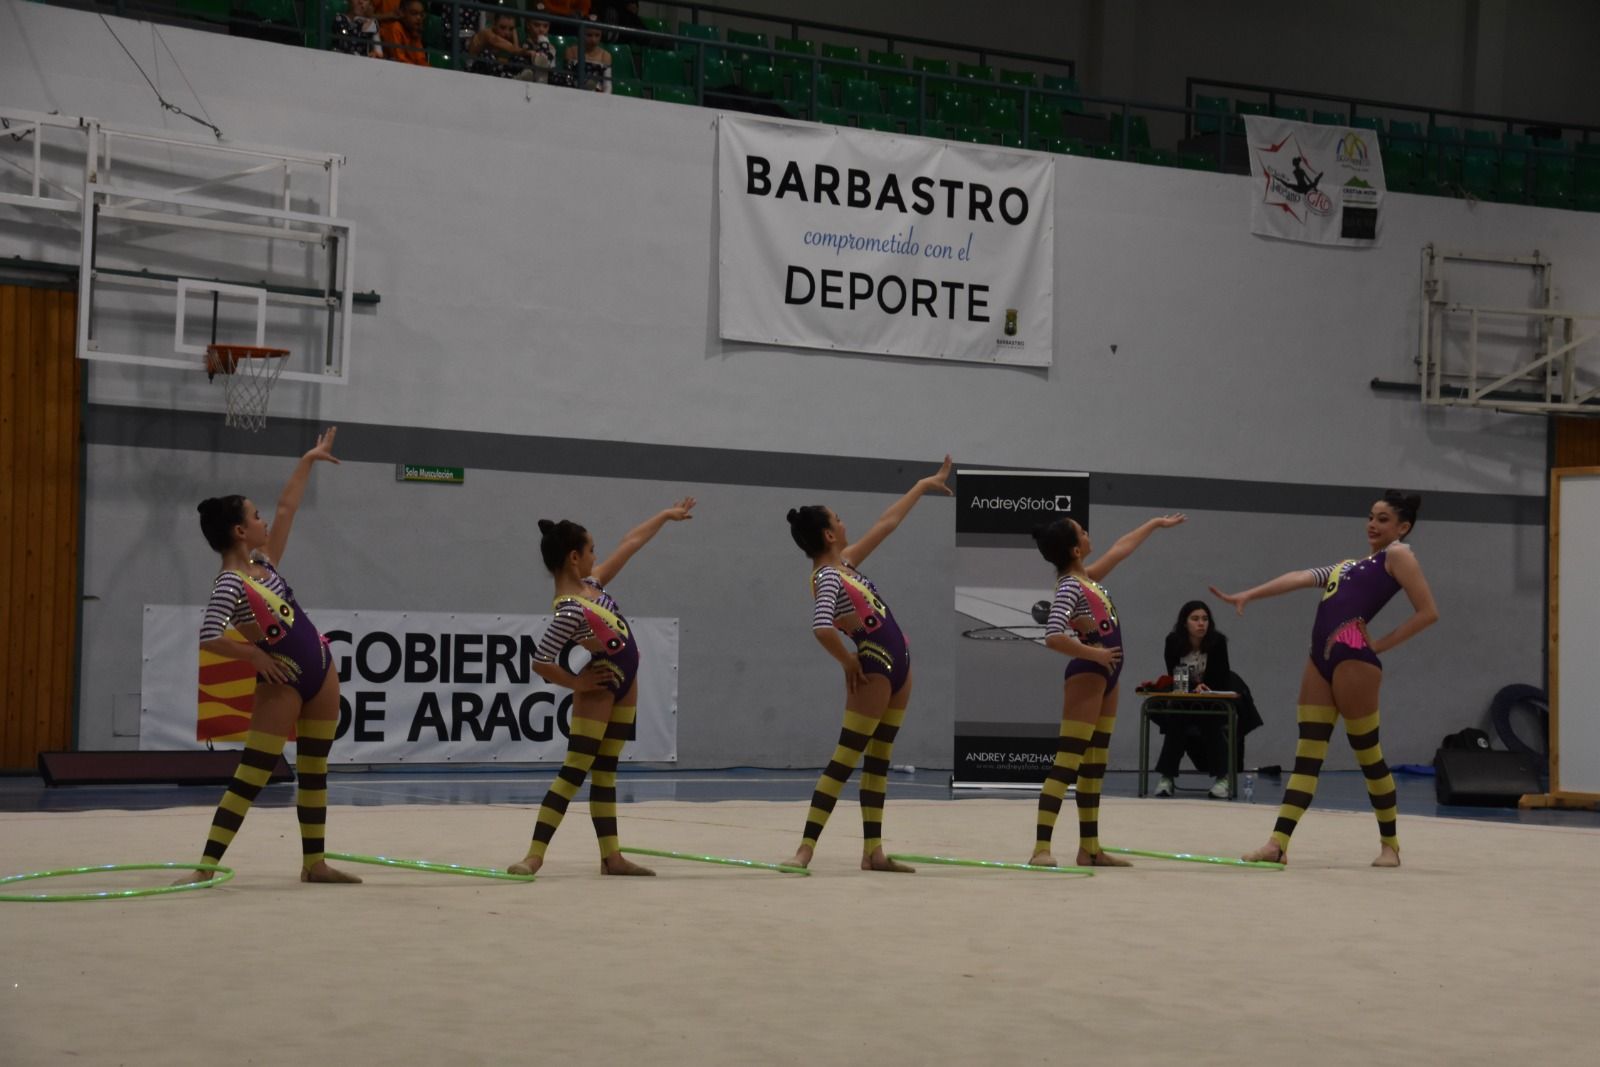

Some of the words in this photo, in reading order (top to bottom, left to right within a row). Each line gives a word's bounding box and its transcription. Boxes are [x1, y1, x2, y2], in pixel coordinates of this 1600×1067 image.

[746, 154, 1029, 226] BARBASTRO
[803, 225, 920, 257] comprometido
[924, 243, 953, 260] con
[957, 232, 974, 262] el
[785, 264, 991, 323] DEPORTE
[970, 495, 1055, 512] AndreySfoto
[406, 690, 636, 742] ARAG
[965, 752, 1006, 762] ANDREY
